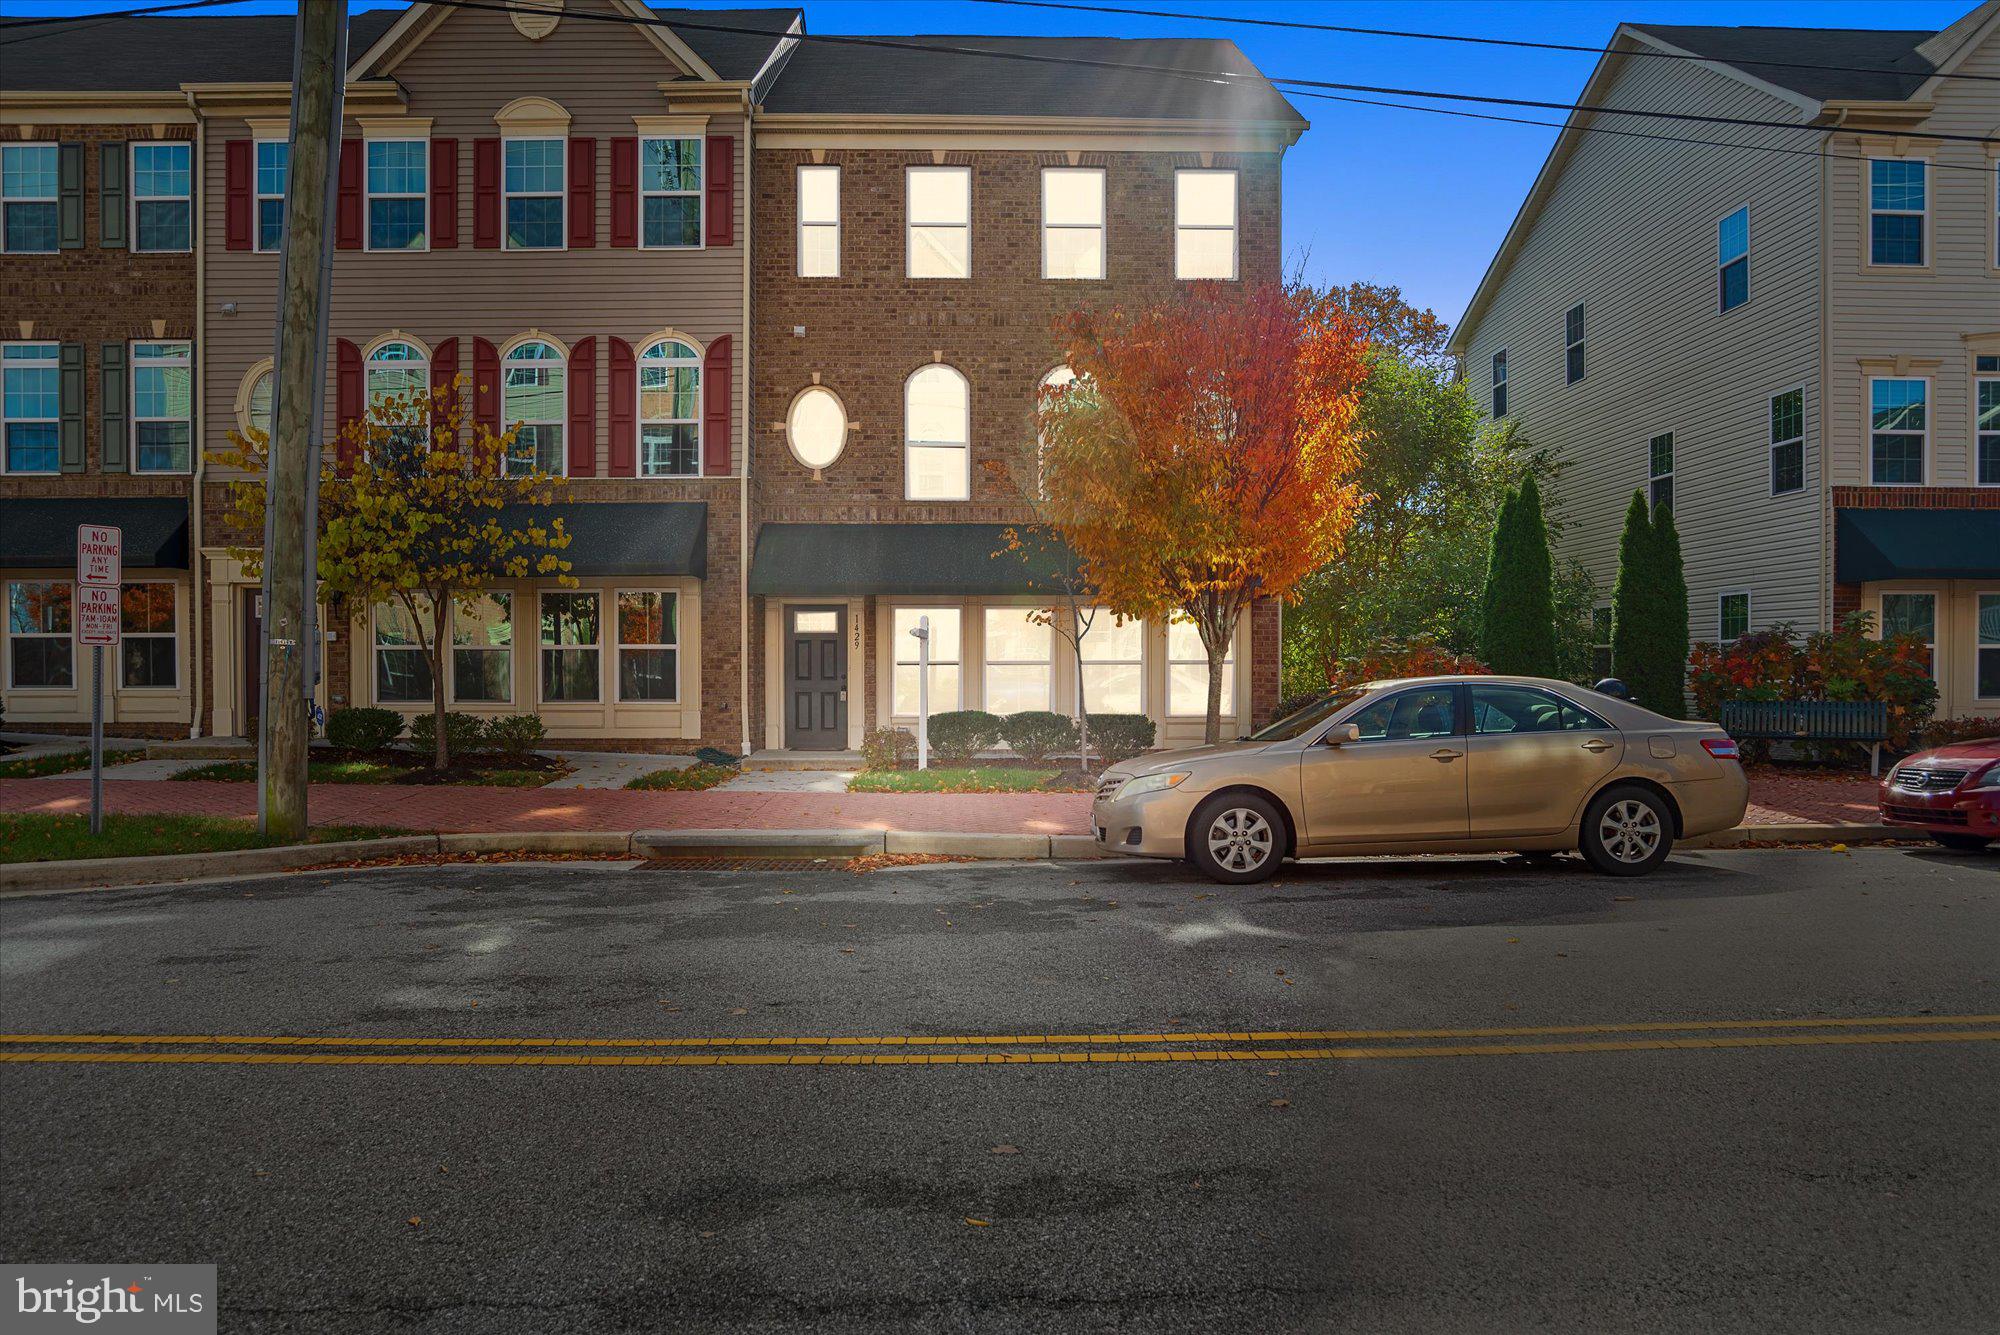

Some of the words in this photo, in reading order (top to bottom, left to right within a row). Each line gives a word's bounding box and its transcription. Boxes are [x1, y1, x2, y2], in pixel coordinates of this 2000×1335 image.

[91, 531, 108, 543] NO
[81, 543, 118, 556] PARKING
[91, 556, 108, 564] ANY
[89, 564, 109, 573] TIME
[91, 590, 107, 602] NO
[81, 602, 117, 614] PARKING
[81, 614, 117, 623] 7AM-10AM
